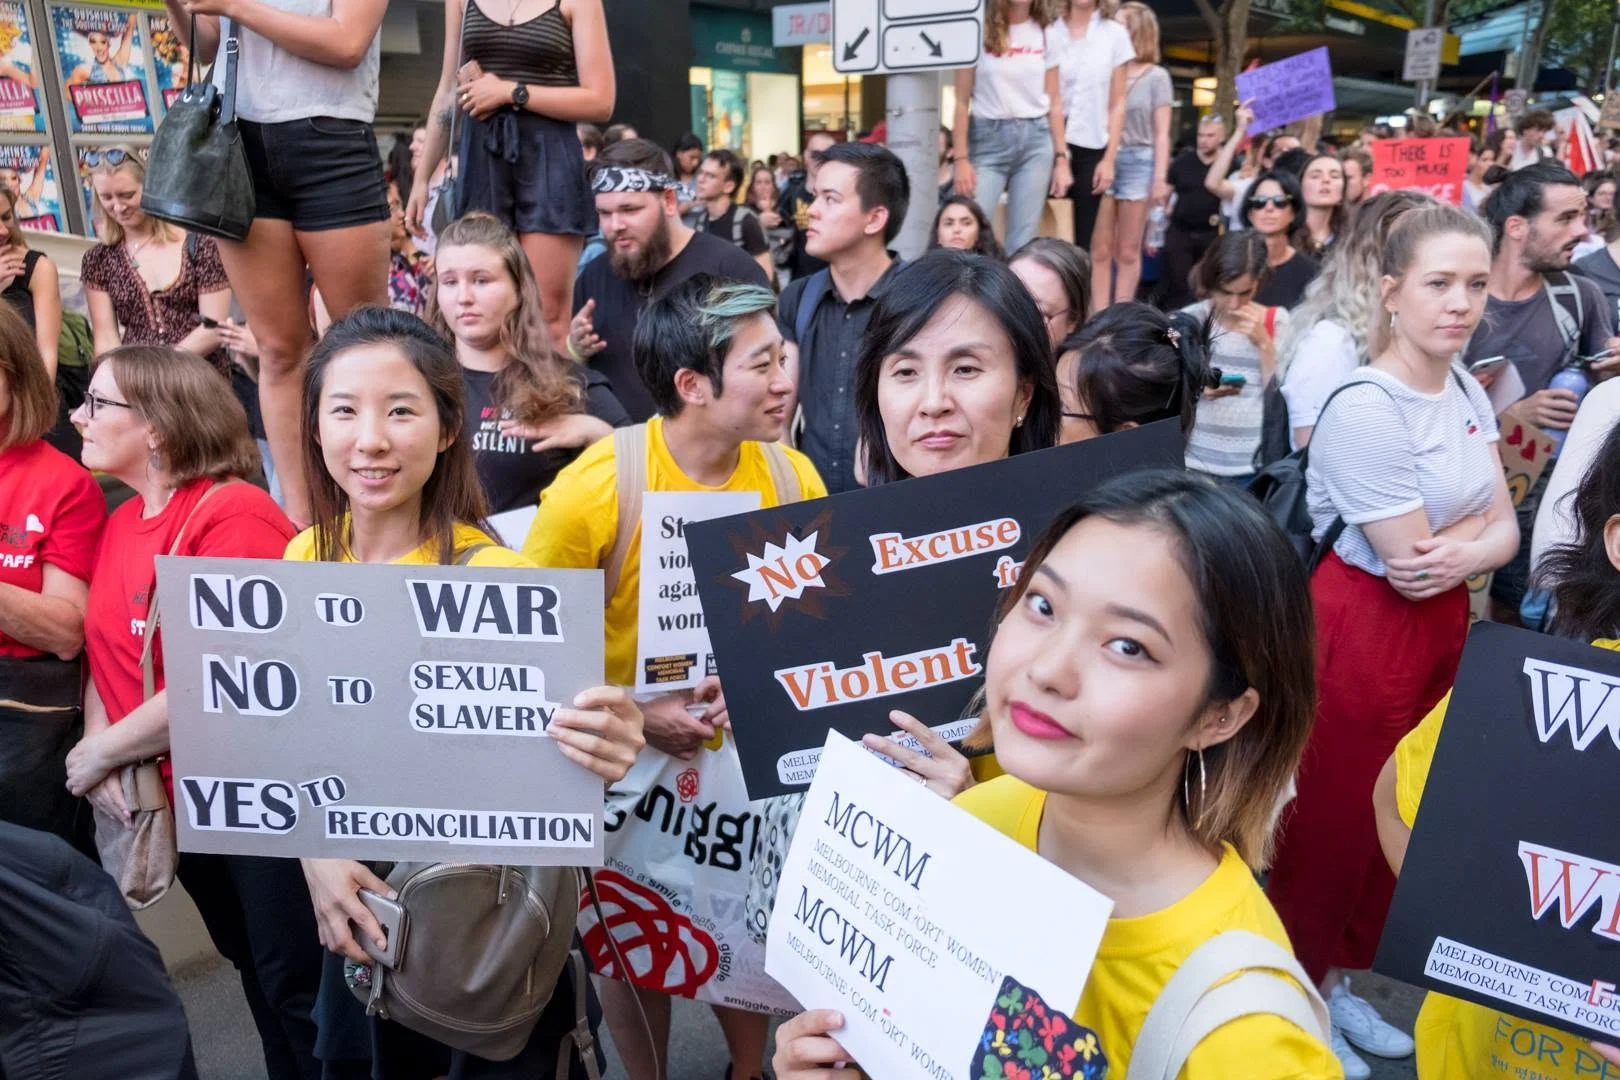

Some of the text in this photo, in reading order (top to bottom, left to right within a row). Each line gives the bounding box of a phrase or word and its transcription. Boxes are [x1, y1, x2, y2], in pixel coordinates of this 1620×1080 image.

[75, 85, 141, 107] PRISCILLA
[1383, 142, 1426, 164] THERE
[661, 515, 696, 539] St
[659, 550, 693, 570] viol
[756, 518, 1018, 600] No Excuse
[999, 560, 1023, 586] fo
[193, 577, 560, 636] NO TO WAR
[658, 612, 708, 631] wom
[209, 661, 374, 712] NO TO
[413, 664, 539, 693] SEXUAL
[781, 641, 977, 708] Violent
[414, 703, 558, 732] SLAVERY
[183, 776, 346, 831] YES TO
[328, 809, 592, 843] RECONCILIATION
[824, 791, 931, 890] MCWM
[648, 879, 681, 907] smile
[814, 838, 880, 897] MELBOURNE
[794, 885, 895, 993] MCWM
[808, 858, 938, 969] MEMORIAL TASK FORCE
[786, 931, 848, 995] MELBOURNE
[1436, 942, 1541, 986] MELBOURNE
[1430, 959, 1620, 1031] MEMORIAL TASK FORC
[1495, 1016, 1564, 1067] FOR
